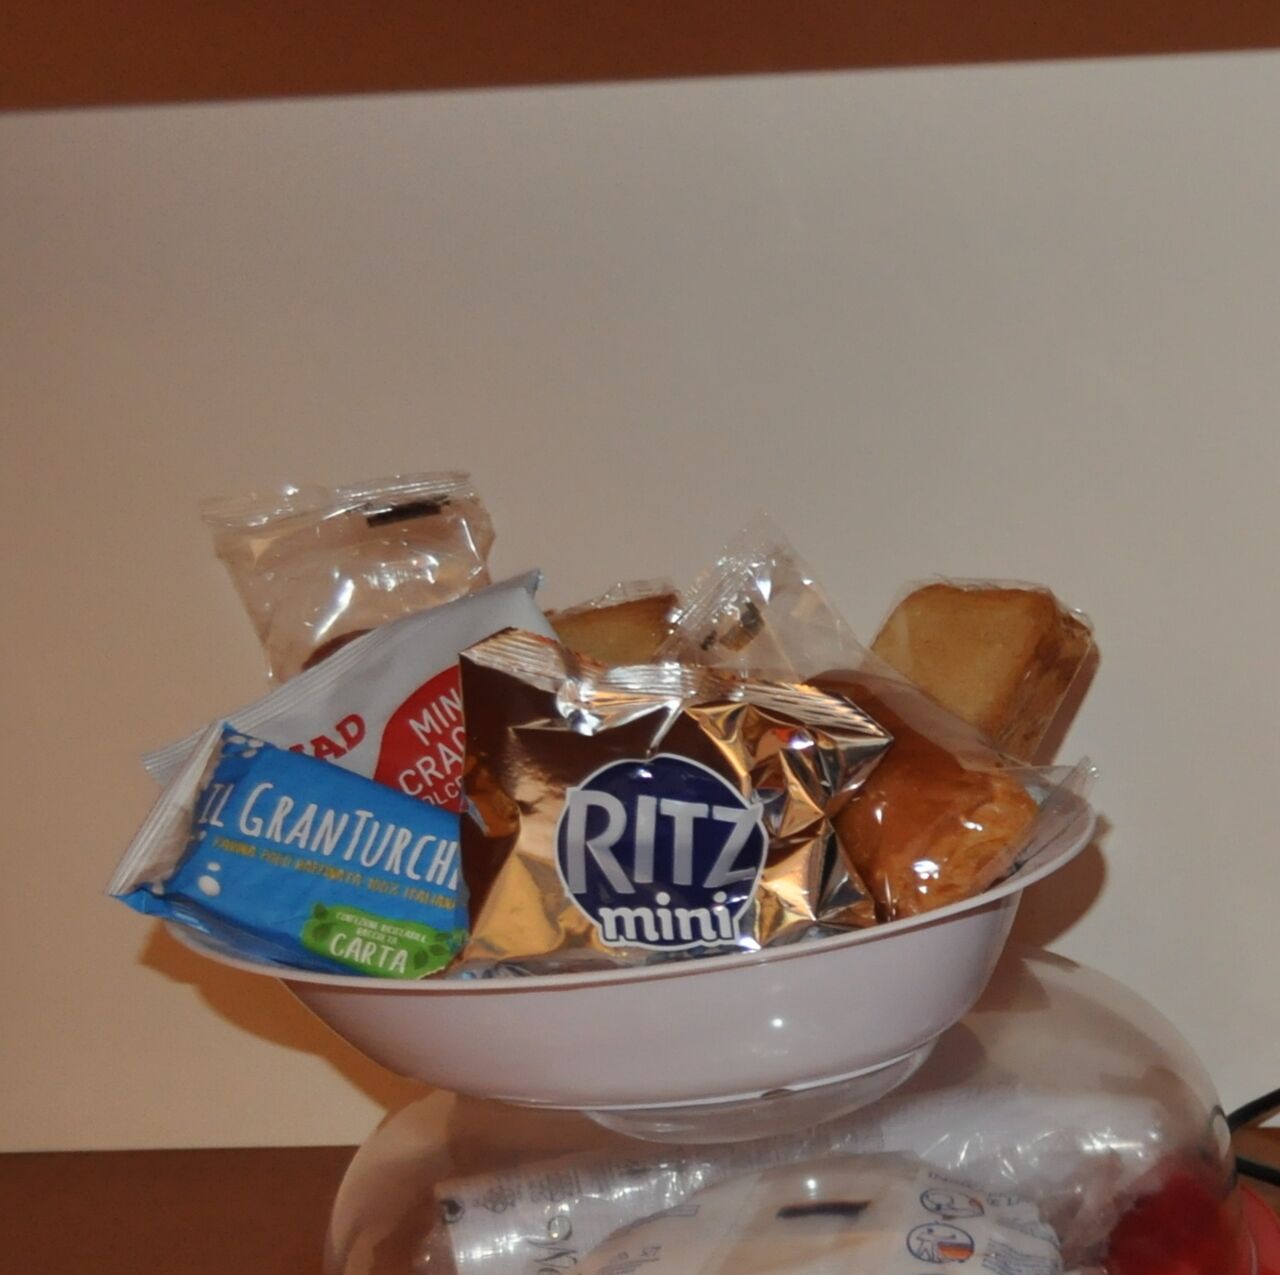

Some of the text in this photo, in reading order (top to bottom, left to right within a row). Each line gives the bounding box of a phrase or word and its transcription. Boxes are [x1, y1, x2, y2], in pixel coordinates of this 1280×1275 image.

[565, 788, 764, 896] RITZ
[599, 891, 738, 943] mini
[328, 932, 410, 974] CARTA
